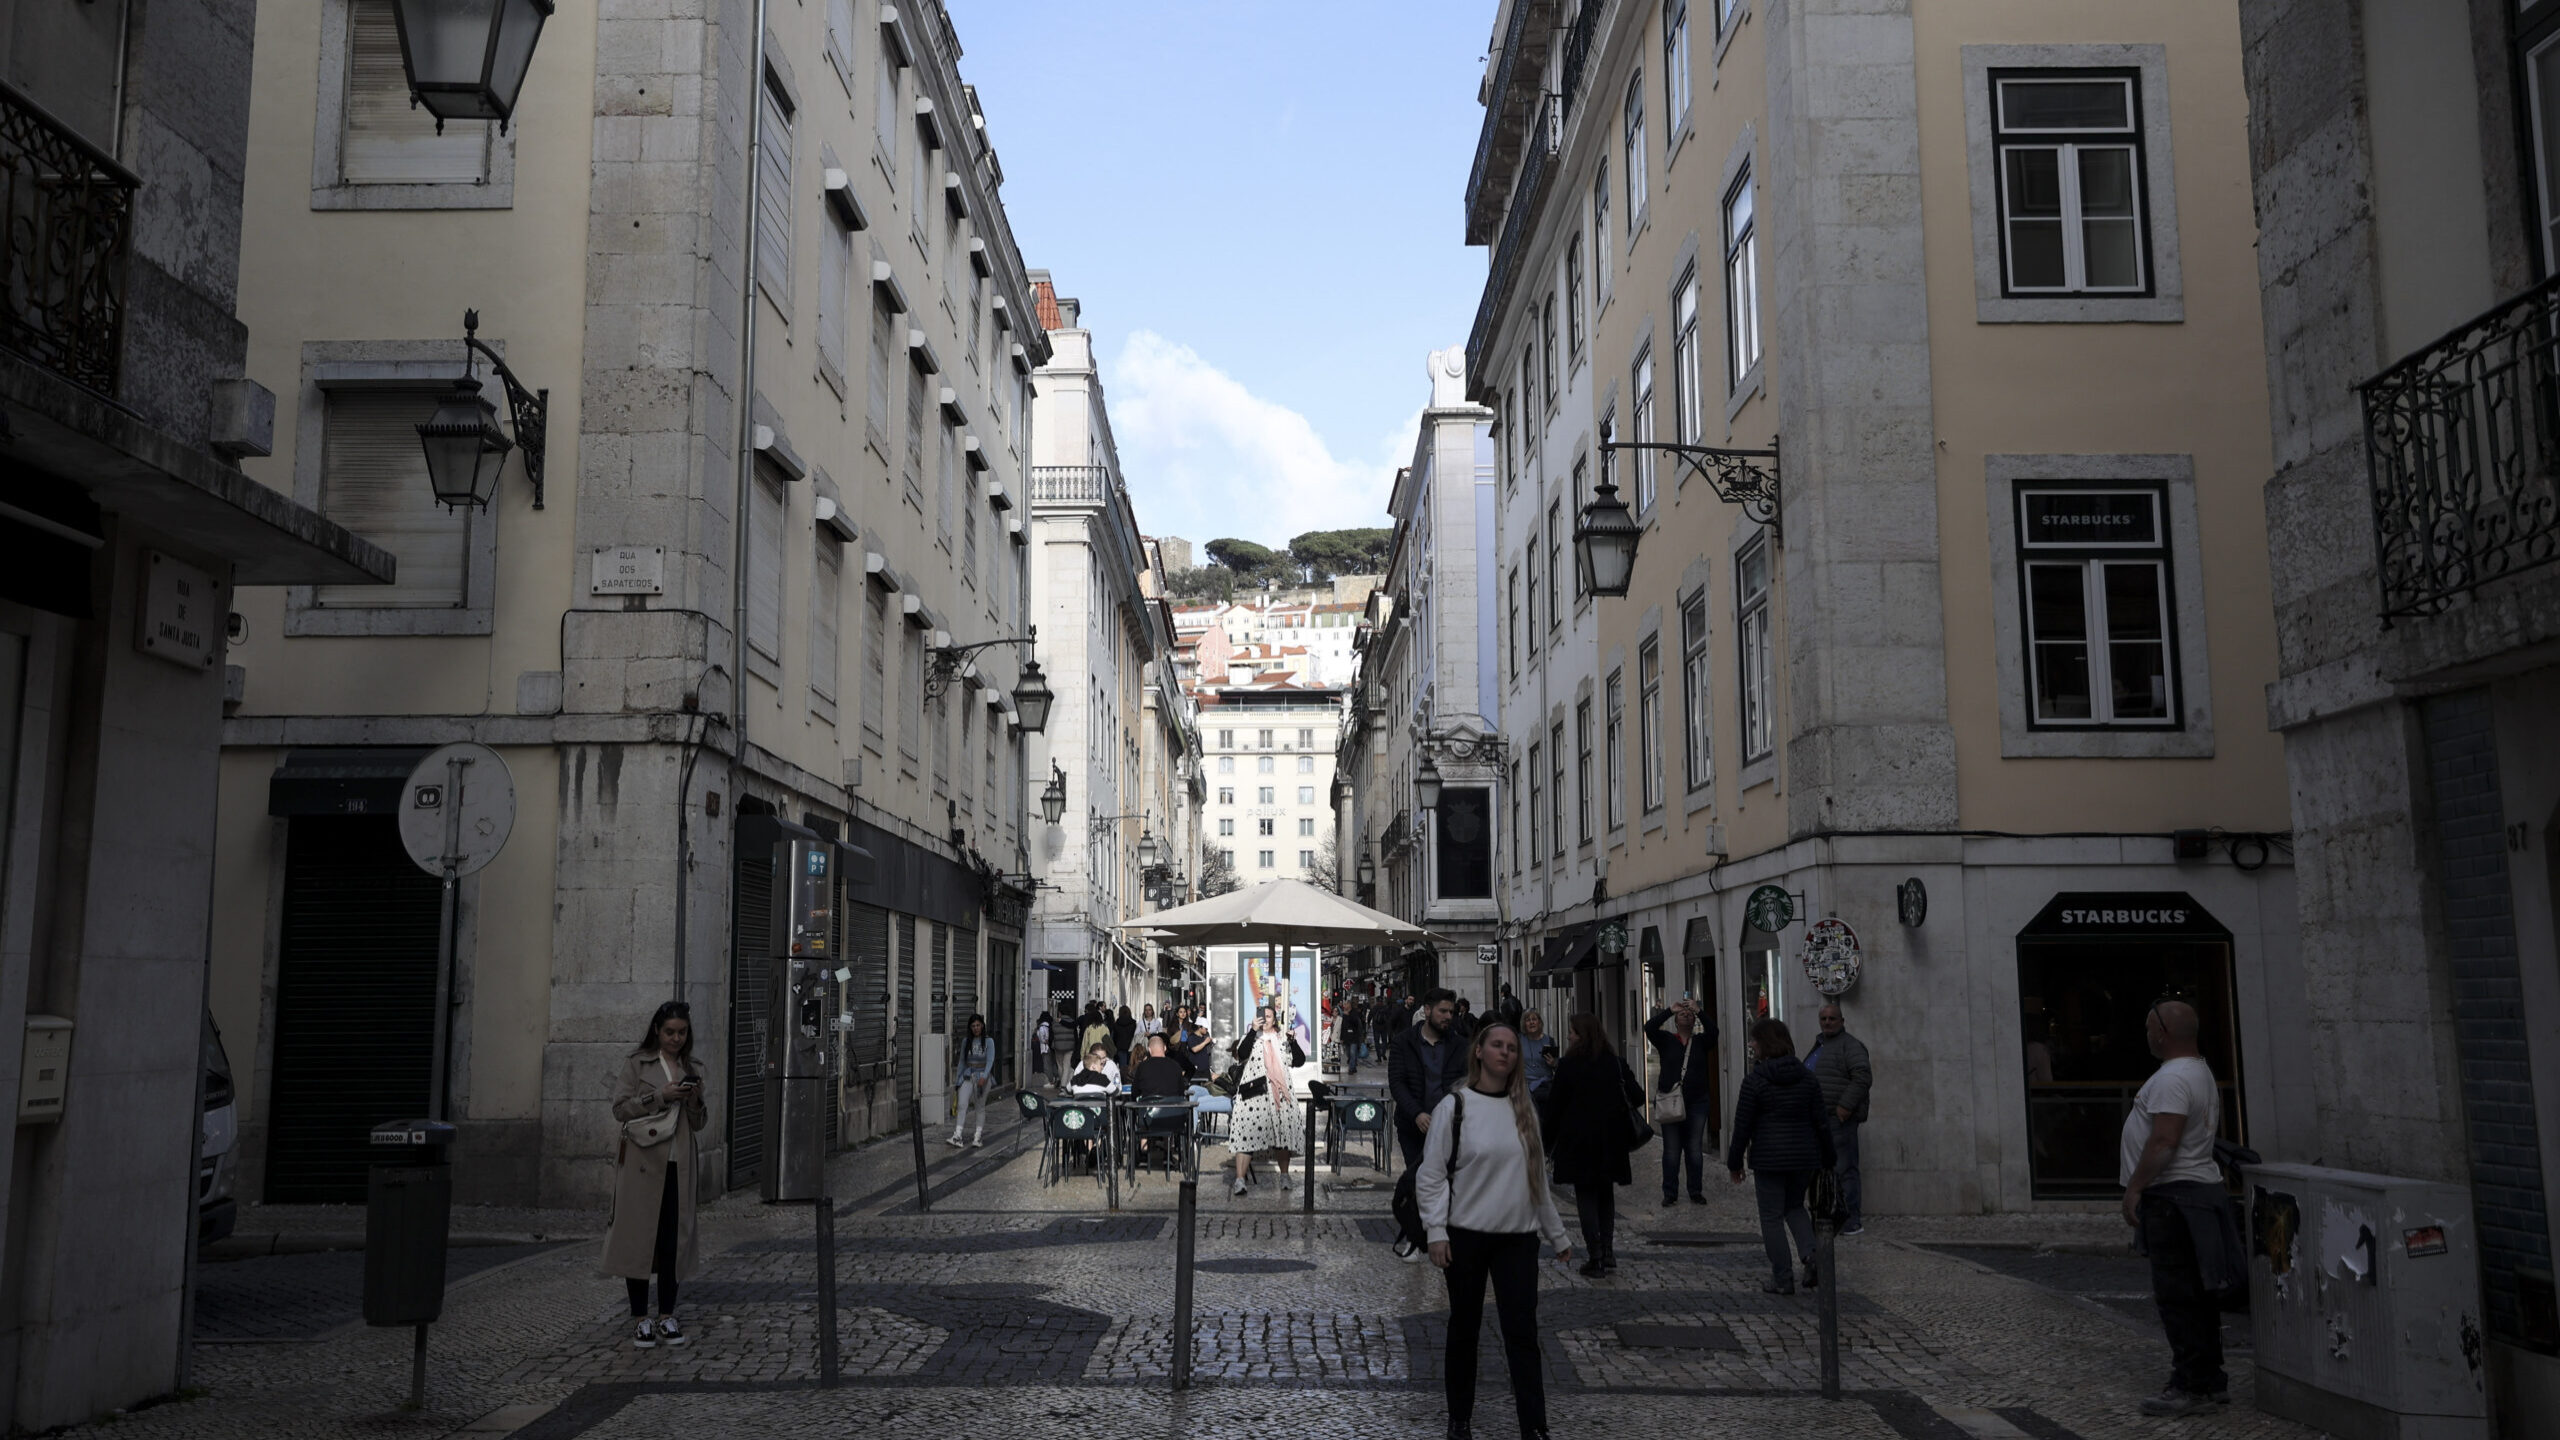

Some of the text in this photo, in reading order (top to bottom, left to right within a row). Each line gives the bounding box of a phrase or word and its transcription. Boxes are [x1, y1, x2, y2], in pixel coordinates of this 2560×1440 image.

[2041, 514, 2131, 525] STARBUCKS
[619, 551, 636, 560] RUA
[619, 565, 635, 574] DOS
[177, 578, 190, 597] RUA
[601, 579, 653, 588] SAPATEIROS
[178, 603, 186, 620] DE
[159, 622, 200, 649] SANTA JUSTA
[811, 864, 824, 873] PT
[2060, 909, 2186, 924] STARBUCKS
[1479, 953, 1496, 962] Lisa
